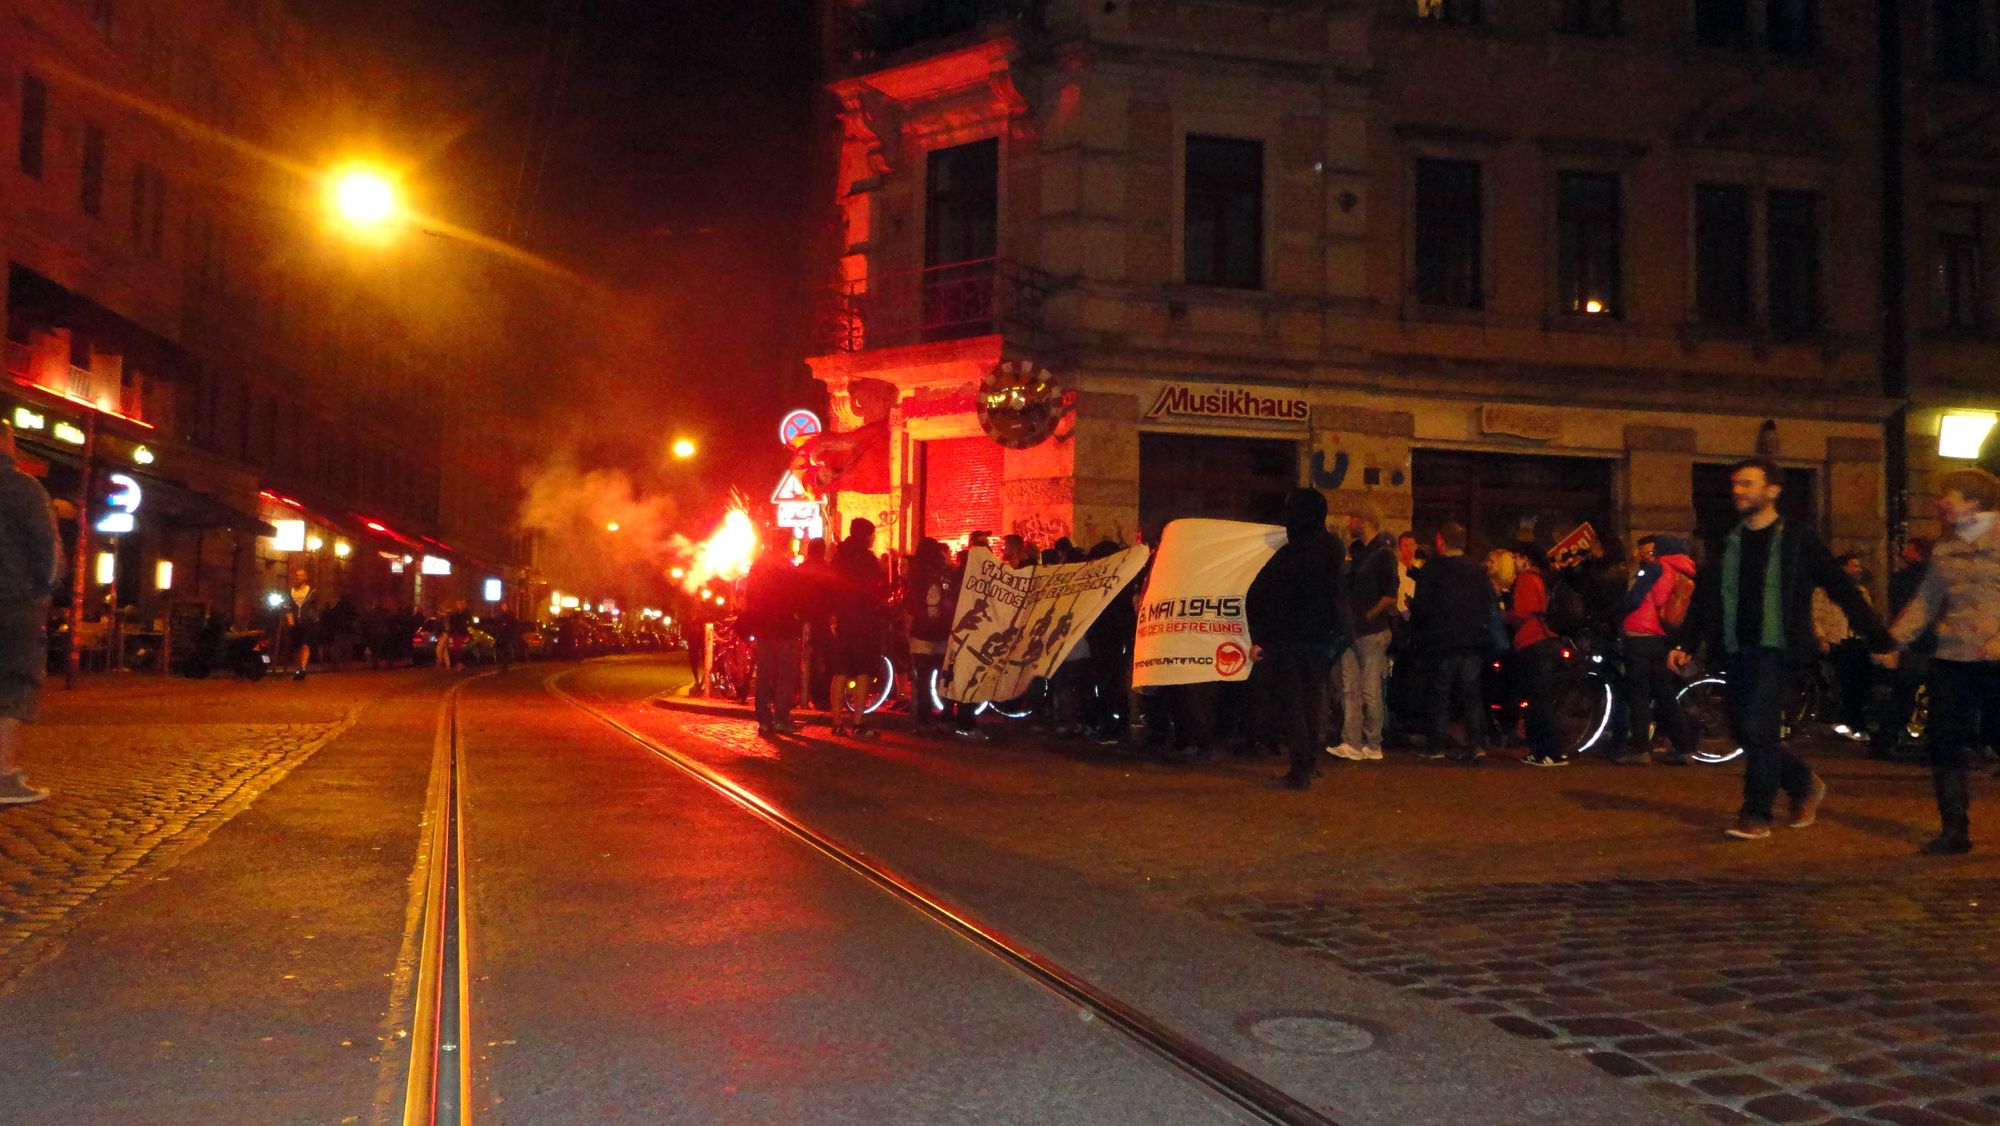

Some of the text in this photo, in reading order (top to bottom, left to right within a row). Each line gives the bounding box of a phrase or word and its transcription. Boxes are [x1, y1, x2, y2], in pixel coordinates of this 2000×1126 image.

[1151, 385, 1309, 419] Musikhaus
[1149, 598, 1175, 621] MAI
[1176, 597, 1242, 618] 1945
[1165, 620, 1243, 634] BEFREIUNG
